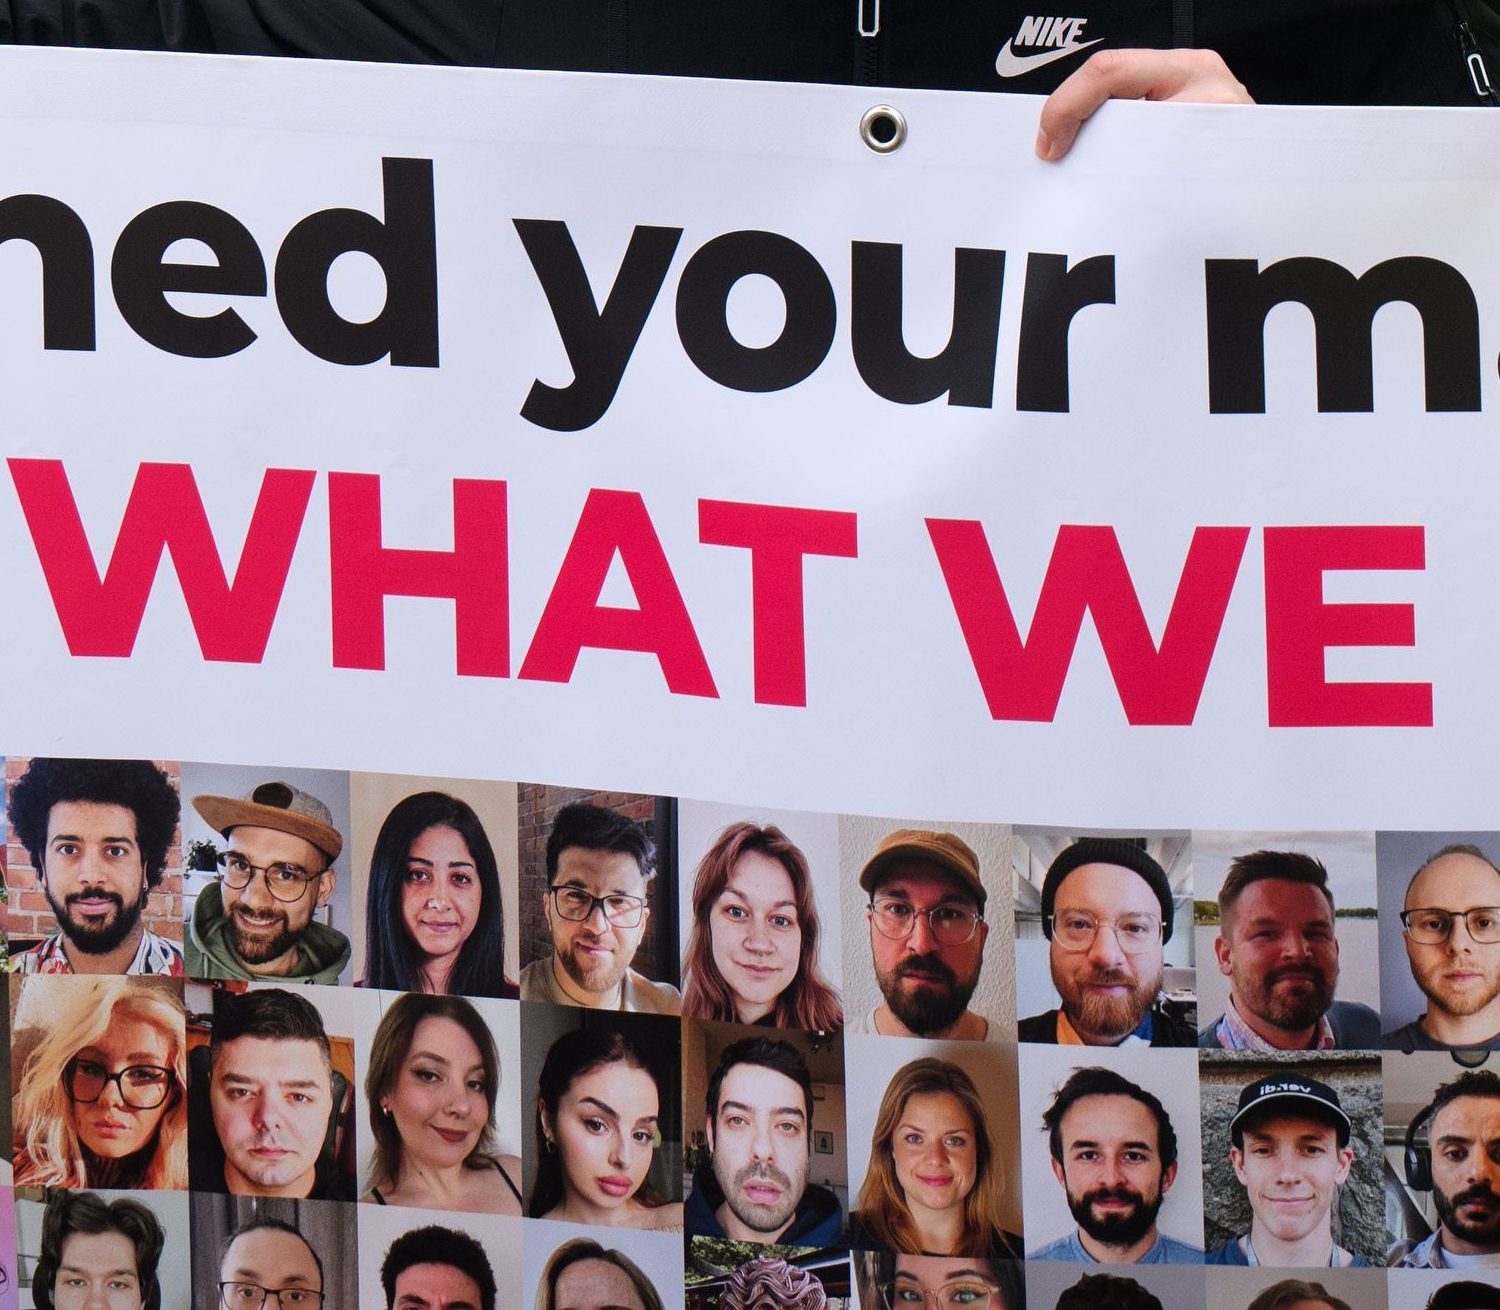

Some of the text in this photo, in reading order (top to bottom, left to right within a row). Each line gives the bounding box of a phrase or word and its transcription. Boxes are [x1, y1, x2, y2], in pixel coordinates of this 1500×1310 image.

[1014, 16, 1088, 48] NIKE
[511, 218, 1116, 432] your
[6, 457, 859, 708] WHAT
[924, 517, 1434, 728] WE
